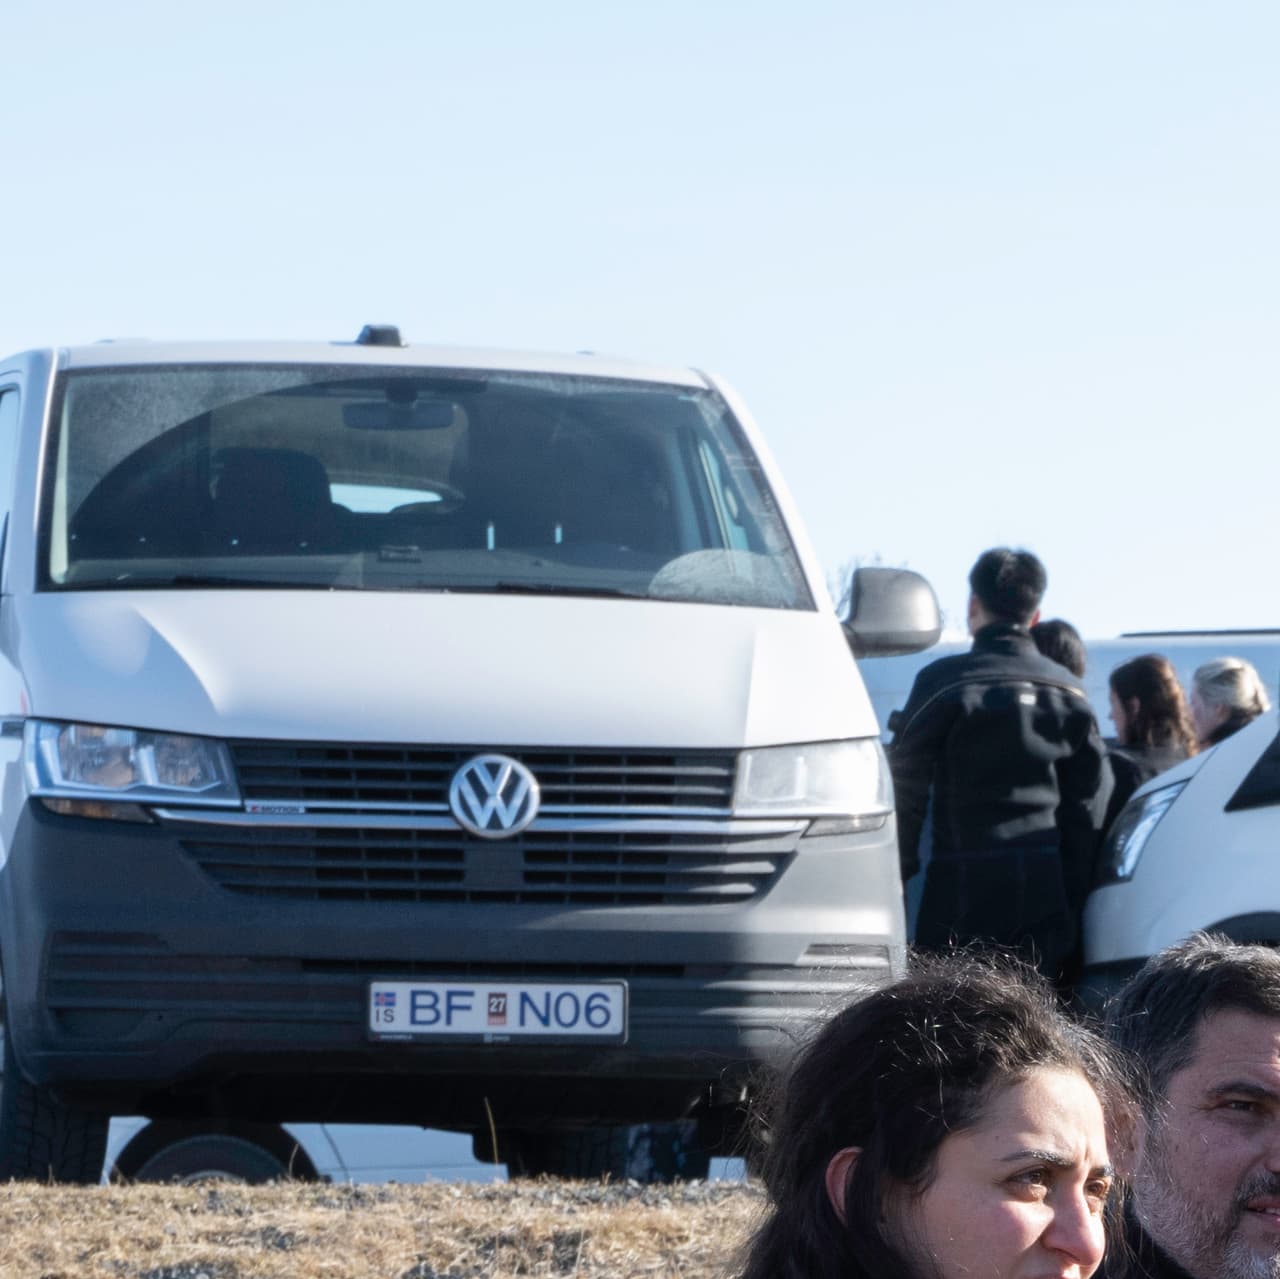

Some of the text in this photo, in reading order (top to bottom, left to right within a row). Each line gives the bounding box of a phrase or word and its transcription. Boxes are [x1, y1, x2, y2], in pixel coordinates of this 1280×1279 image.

[375, 1008, 395, 1024] IS
[409, 989, 613, 1030] BF N06
